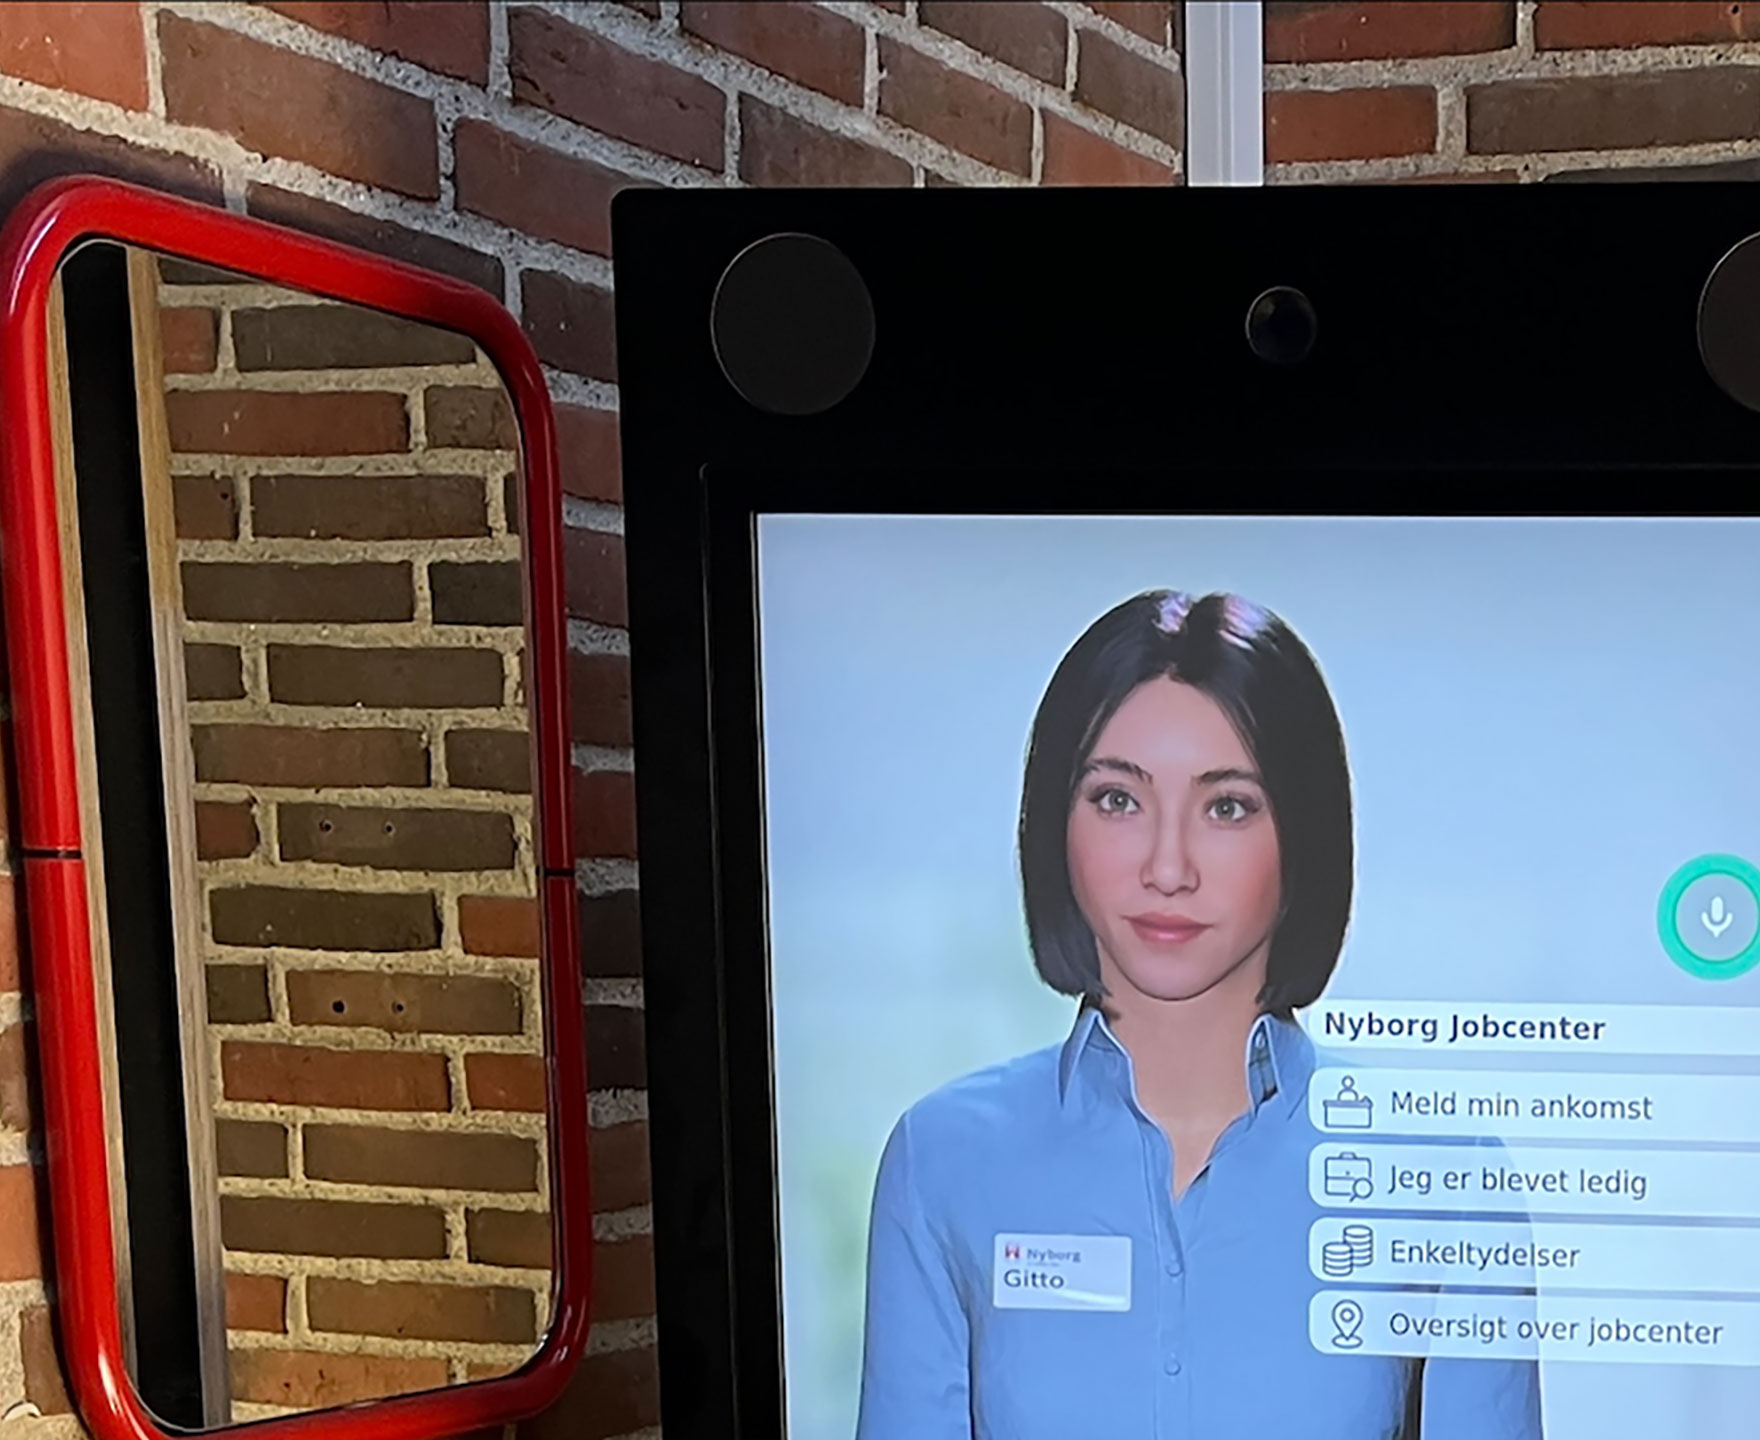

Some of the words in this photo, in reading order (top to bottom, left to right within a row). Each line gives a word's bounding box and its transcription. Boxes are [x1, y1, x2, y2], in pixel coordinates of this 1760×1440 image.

[1325, 1011, 1438, 1041] Nyborg
[1449, 1014, 1606, 1042] Jobcenter
[1391, 1092, 1456, 1116] Meld
[1468, 1093, 1520, 1118] min
[1531, 1094, 1653, 1121] ankomst
[1388, 1164, 1432, 1195] Jeg
[1443, 1171, 1471, 1191] er
[1482, 1167, 1569, 1194] blevet
[1579, 1169, 1648, 1200] ledig
[1027, 1248, 1081, 1263] Nyborg
[1391, 1239, 1581, 1270] Enkeltydelser
[1004, 1268, 1064, 1289] Gitto
[1389, 1314, 1507, 1343] Oversigt
[1517, 1321, 1579, 1341] over
[1589, 1317, 1724, 1346] jobcenter
